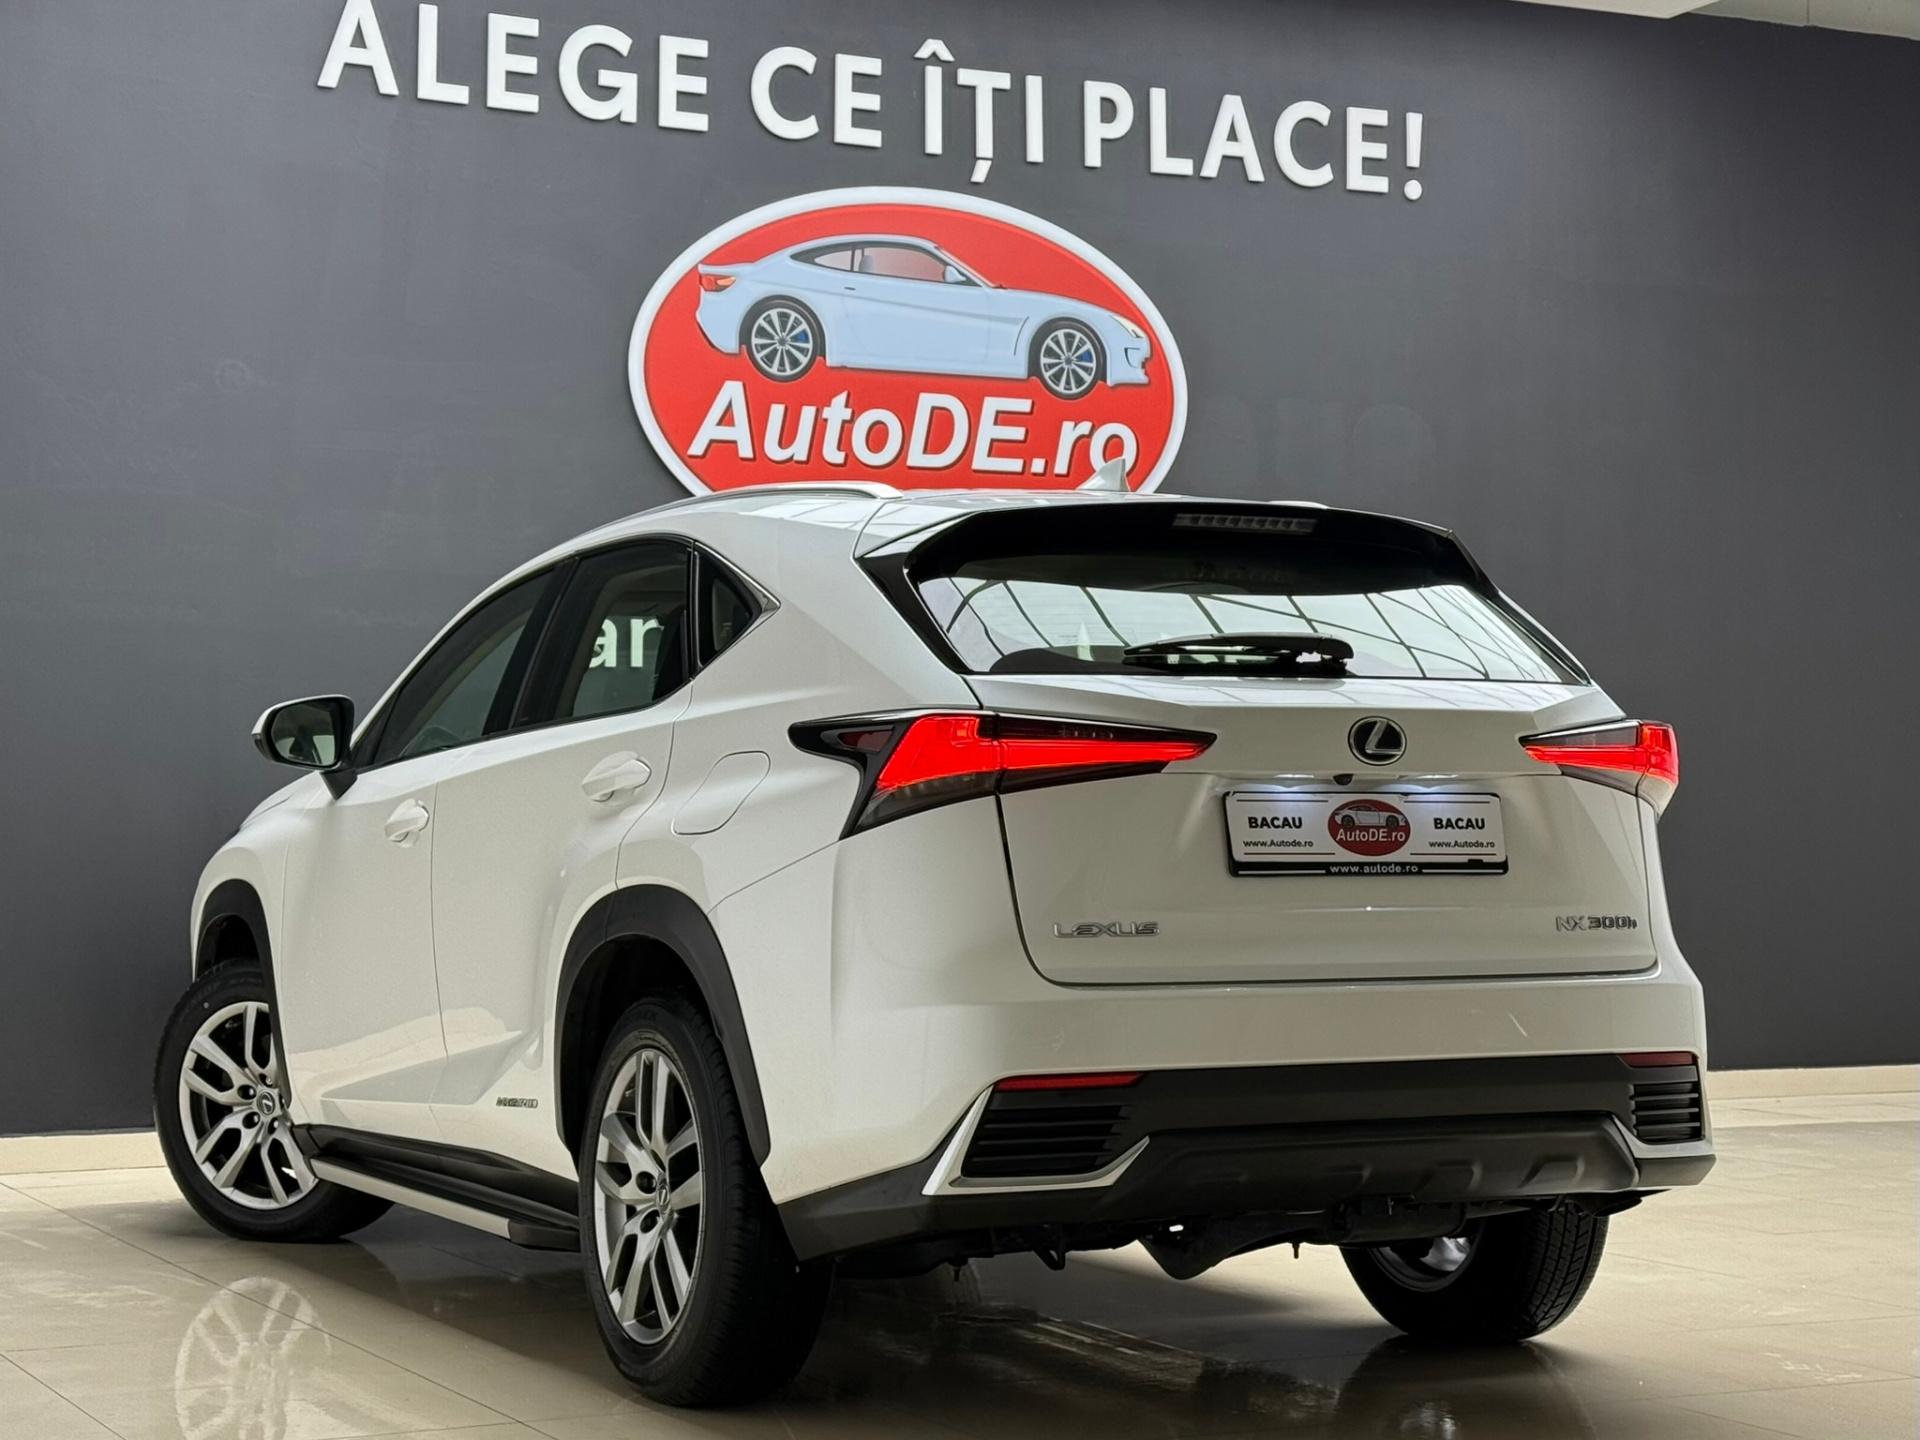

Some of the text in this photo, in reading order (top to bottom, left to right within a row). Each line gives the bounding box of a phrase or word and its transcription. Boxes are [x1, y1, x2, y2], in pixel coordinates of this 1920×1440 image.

[317, 0, 709, 132] ALEGE
[750, 46, 882, 149] CE
[1083, 80, 1423, 200] PLACE!
[687, 379, 1138, 478] AutoDE.ro
[1247, 816, 1303, 829] BACAU
[1433, 817, 1486, 830] BACAU
[1335, 828, 1406, 843] AutoDE.ro
[1329, 863, 1419, 874] www.autode.ro
[1053, 922, 1160, 938] LEXUS
